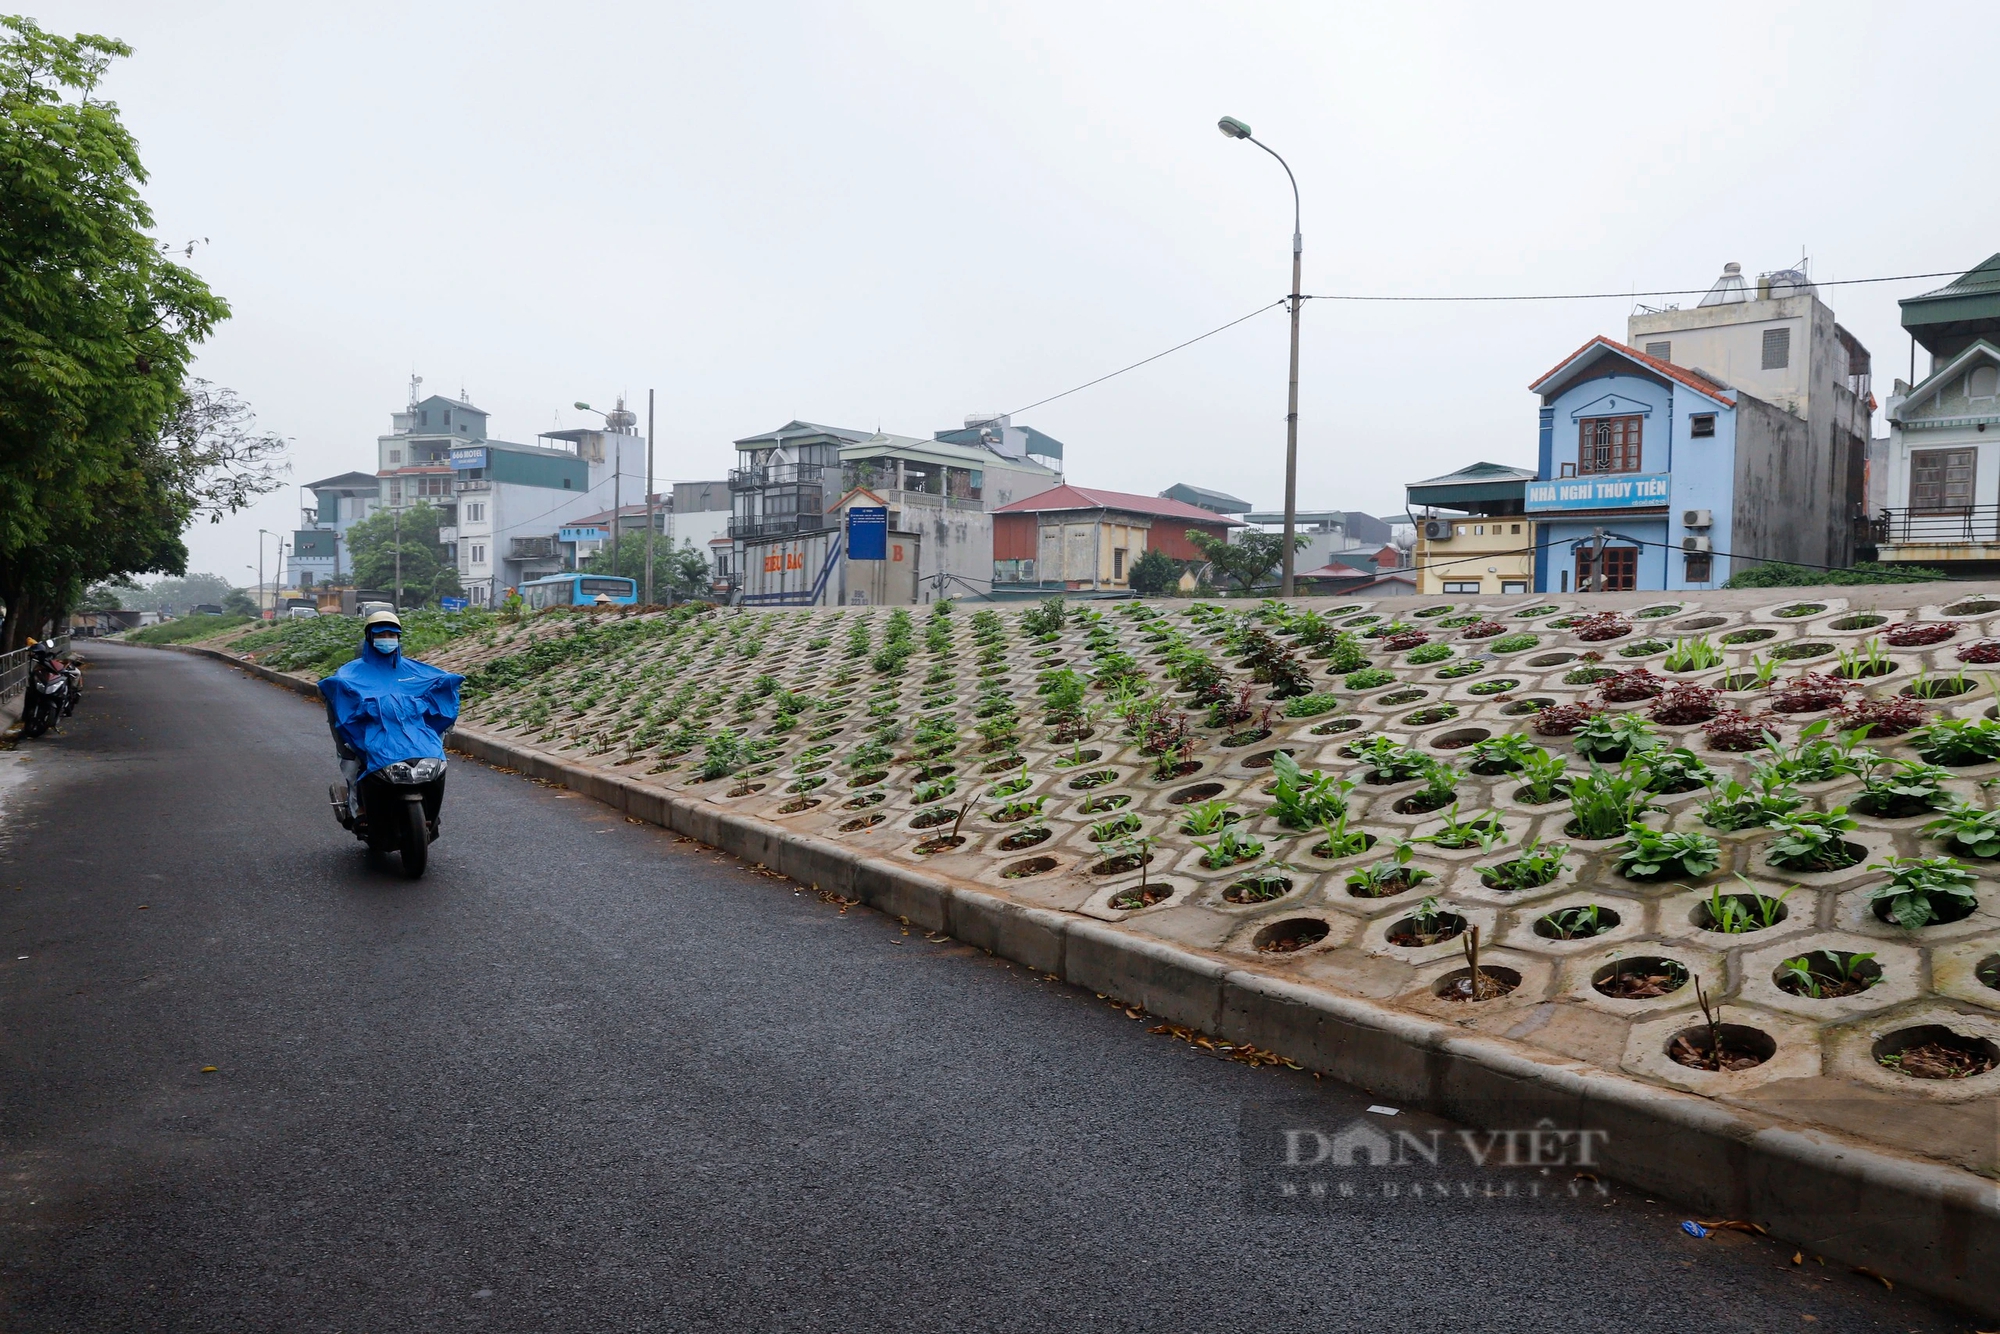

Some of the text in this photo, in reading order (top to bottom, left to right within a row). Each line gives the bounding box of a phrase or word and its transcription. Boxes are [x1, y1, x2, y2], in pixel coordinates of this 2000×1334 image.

[464, 449, 483, 458] MOTEL
[1530, 478, 1667, 502] NHÀ NGHỈ THỦY TIÊN
[891, 544, 904, 562] B
